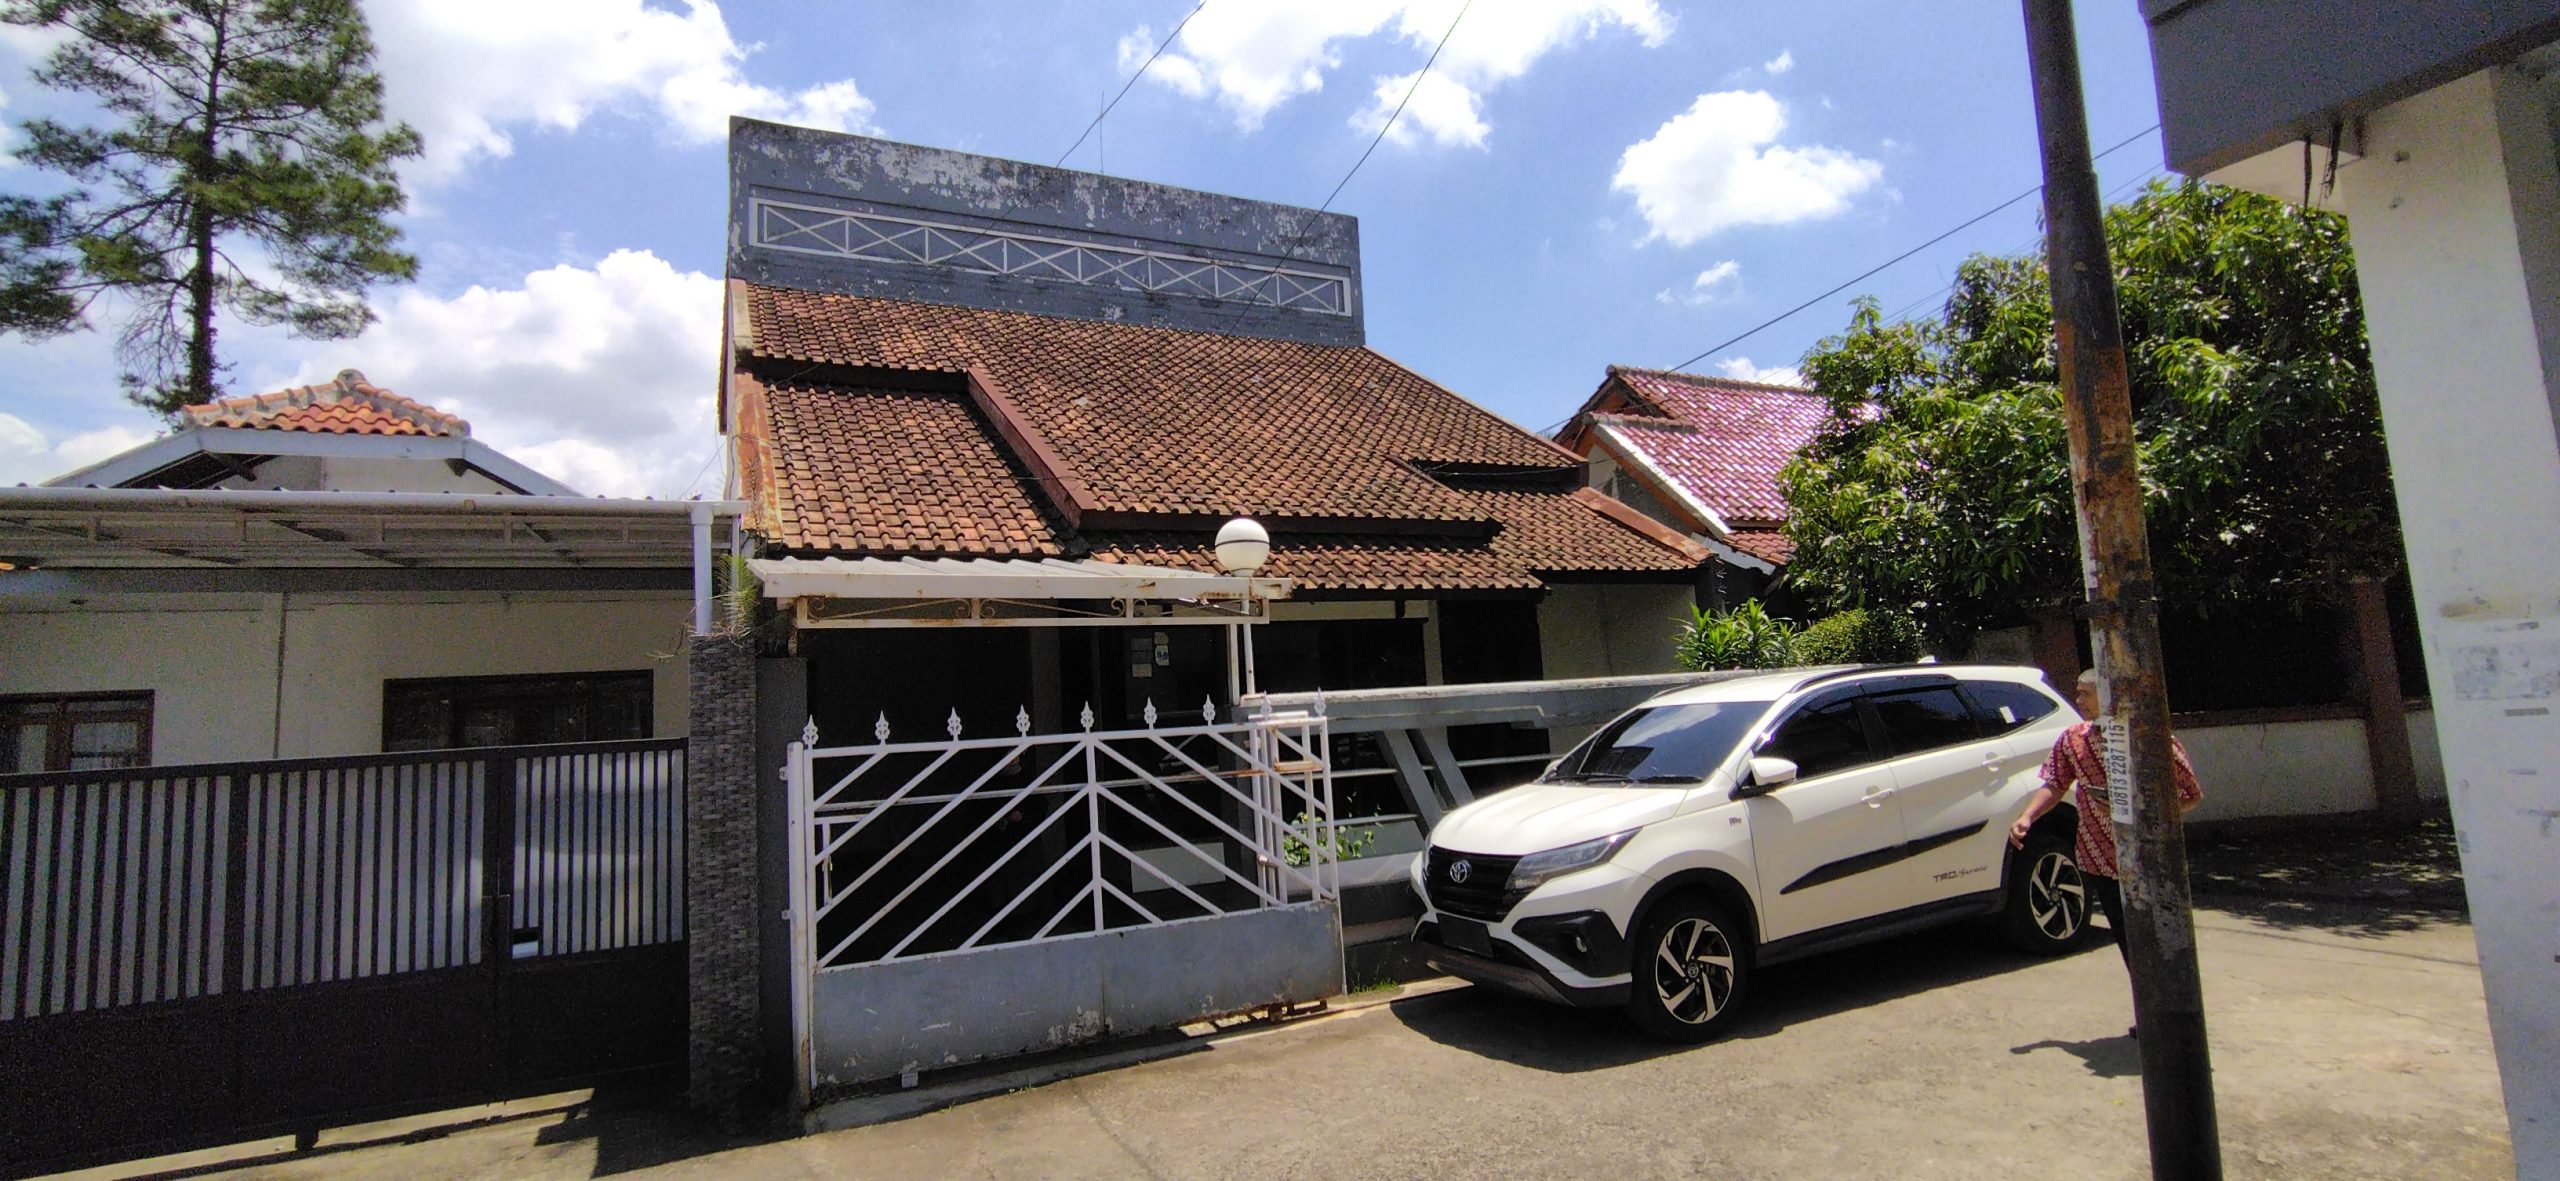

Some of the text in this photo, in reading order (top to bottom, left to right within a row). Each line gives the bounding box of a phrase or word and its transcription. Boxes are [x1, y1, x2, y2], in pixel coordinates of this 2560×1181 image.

[2108, 719, 2125, 744] 115
[2111, 748, 2127, 775] 2287
[2113, 779, 2129, 806] 0813
